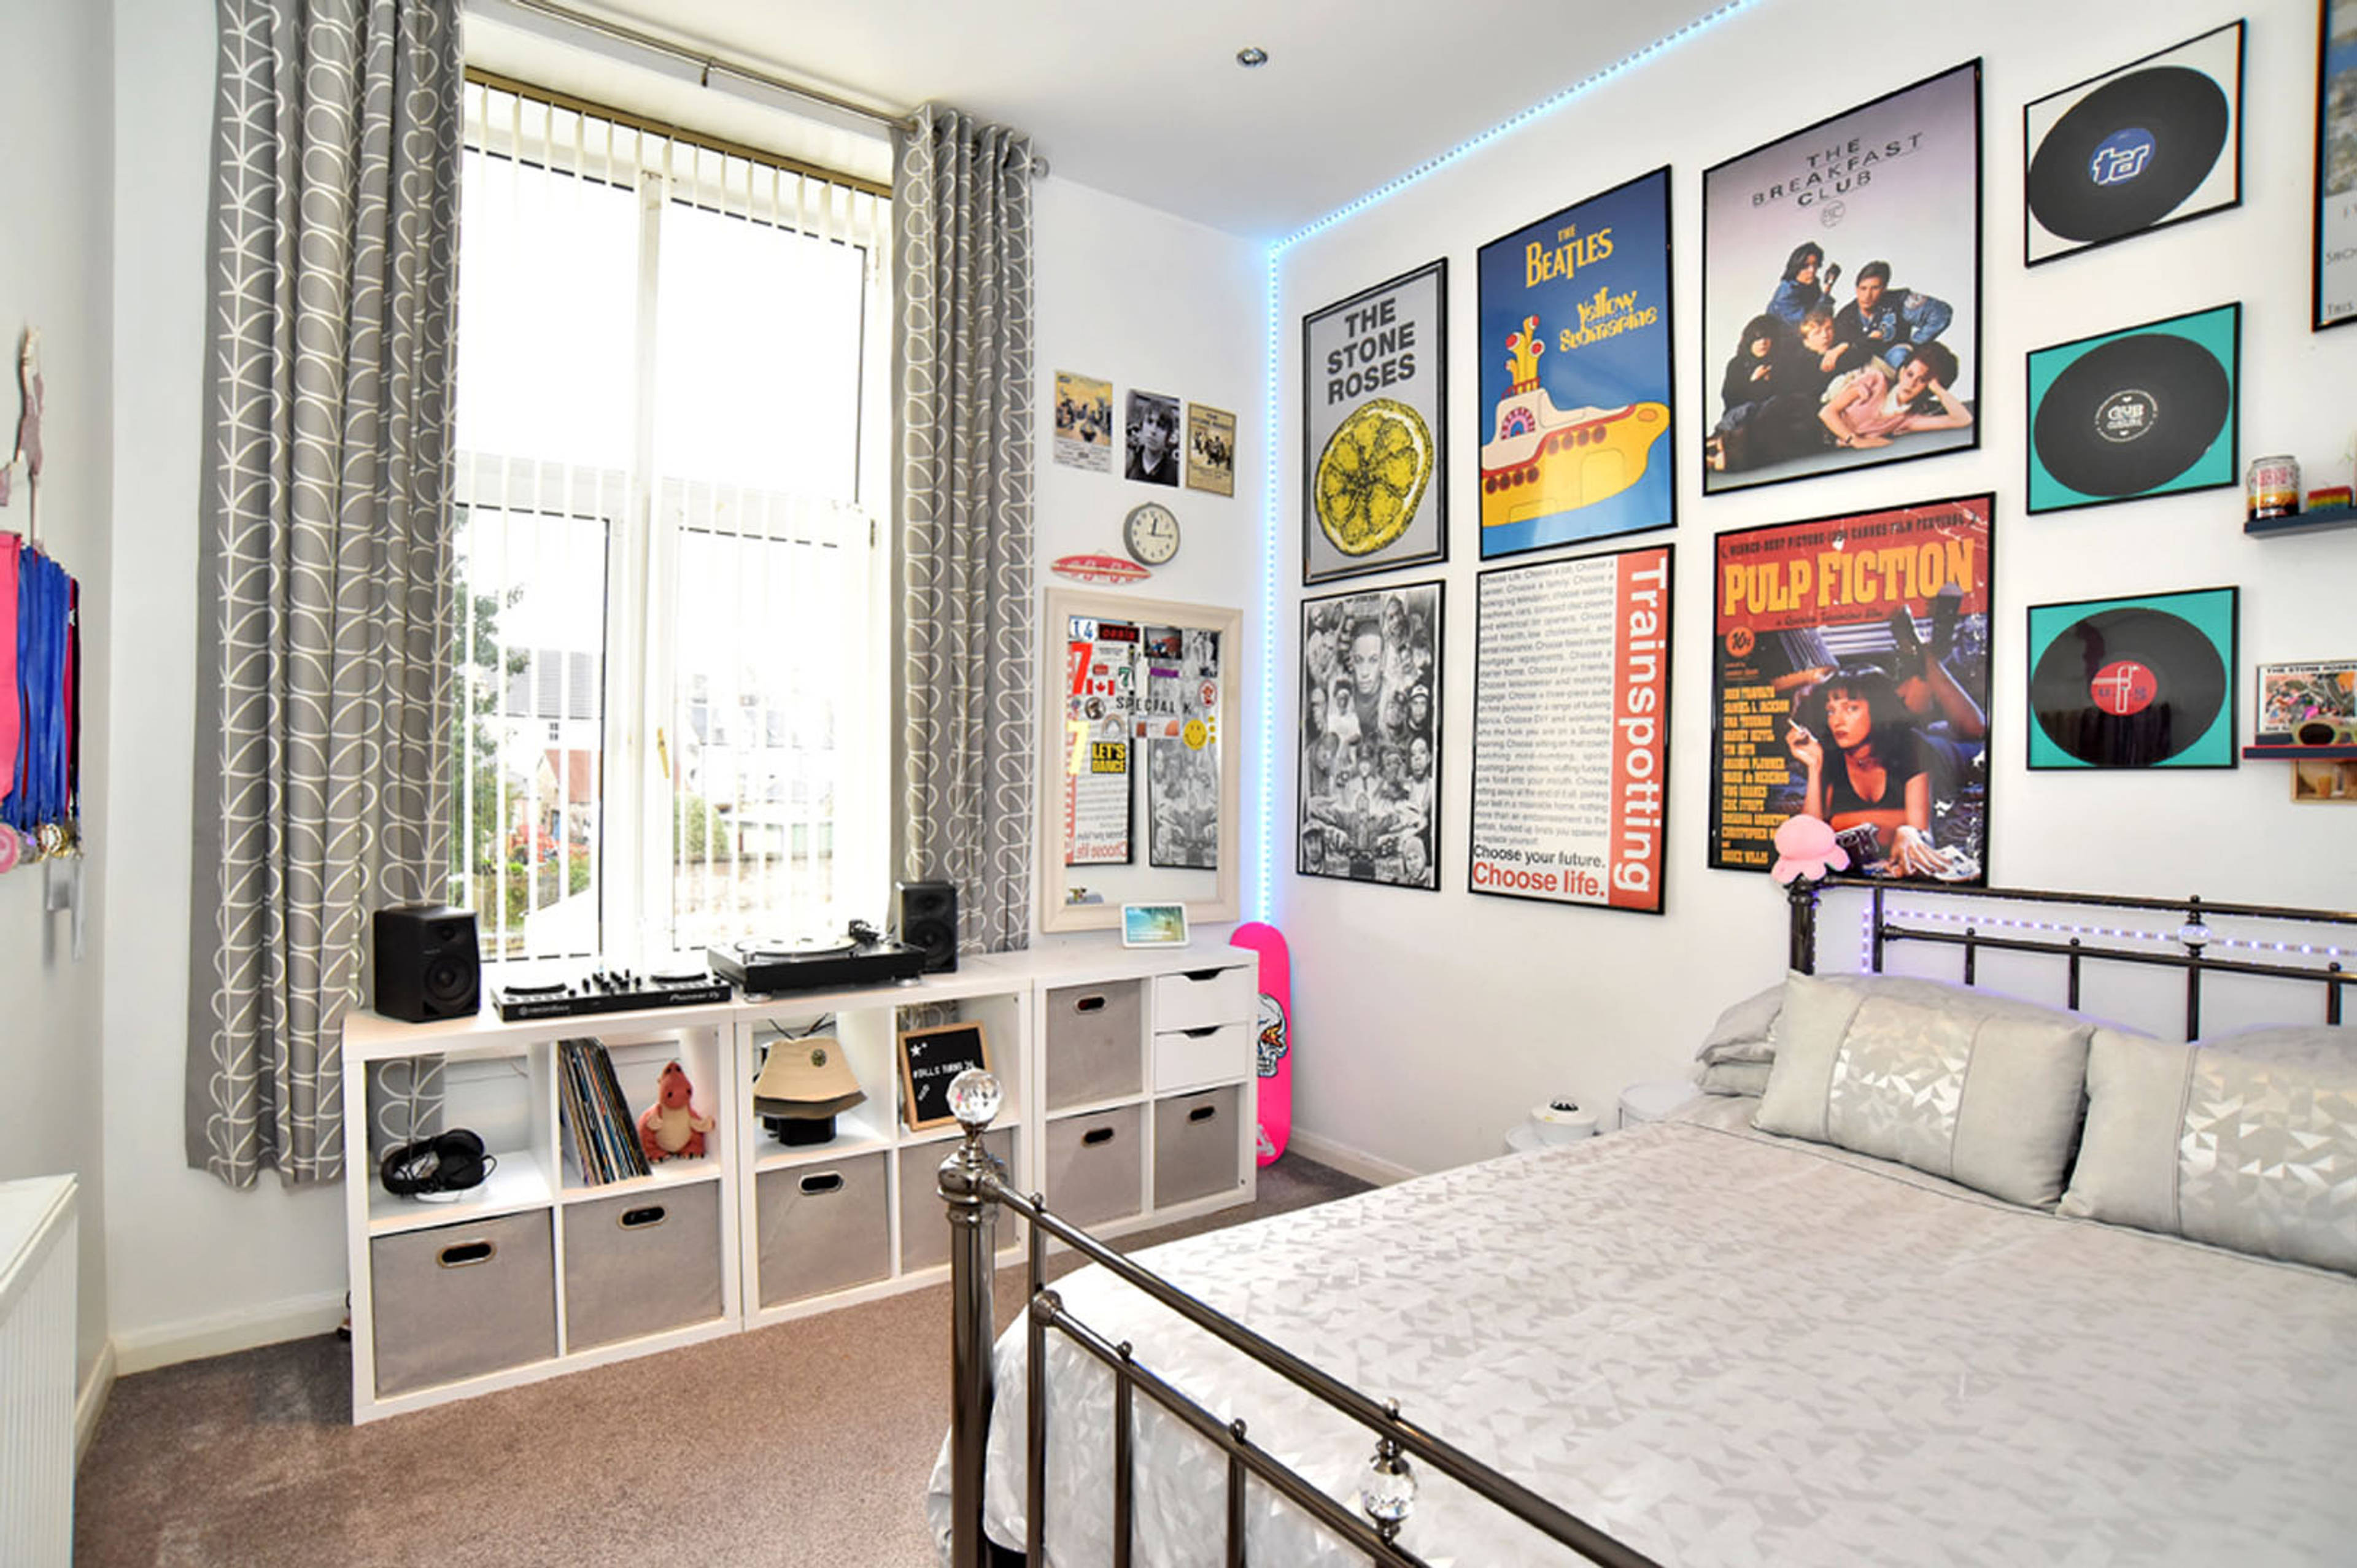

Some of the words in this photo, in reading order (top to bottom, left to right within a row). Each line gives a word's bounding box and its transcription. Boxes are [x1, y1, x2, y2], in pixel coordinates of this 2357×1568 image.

[1752, 132, 1922, 207] BREAKFAST
[1806, 137, 1860, 168] THE
[1797, 170, 1871, 207] CLUB
[1557, 223, 1576, 242] THE
[1525, 227, 1614, 288] BEATLES
[1345, 298, 1396, 338] THE
[1577, 286, 1638, 330] Yellow
[1328, 321, 1415, 374] STONE
[1328, 353, 1415, 405] ROSES
[1724, 559, 1811, 616] PULP
[1817, 538, 1975, 607] FICTION
[1614, 557, 1667, 892] Trainspotting
[1092, 743, 1126, 759] LET'S
[1474, 844, 1522, 861] Choose
[1525, 851, 1555, 866] your
[1558, 851, 1606, 868] future.
[1474, 862, 1558, 892] Choose
[1564, 870, 1605, 897] life.
